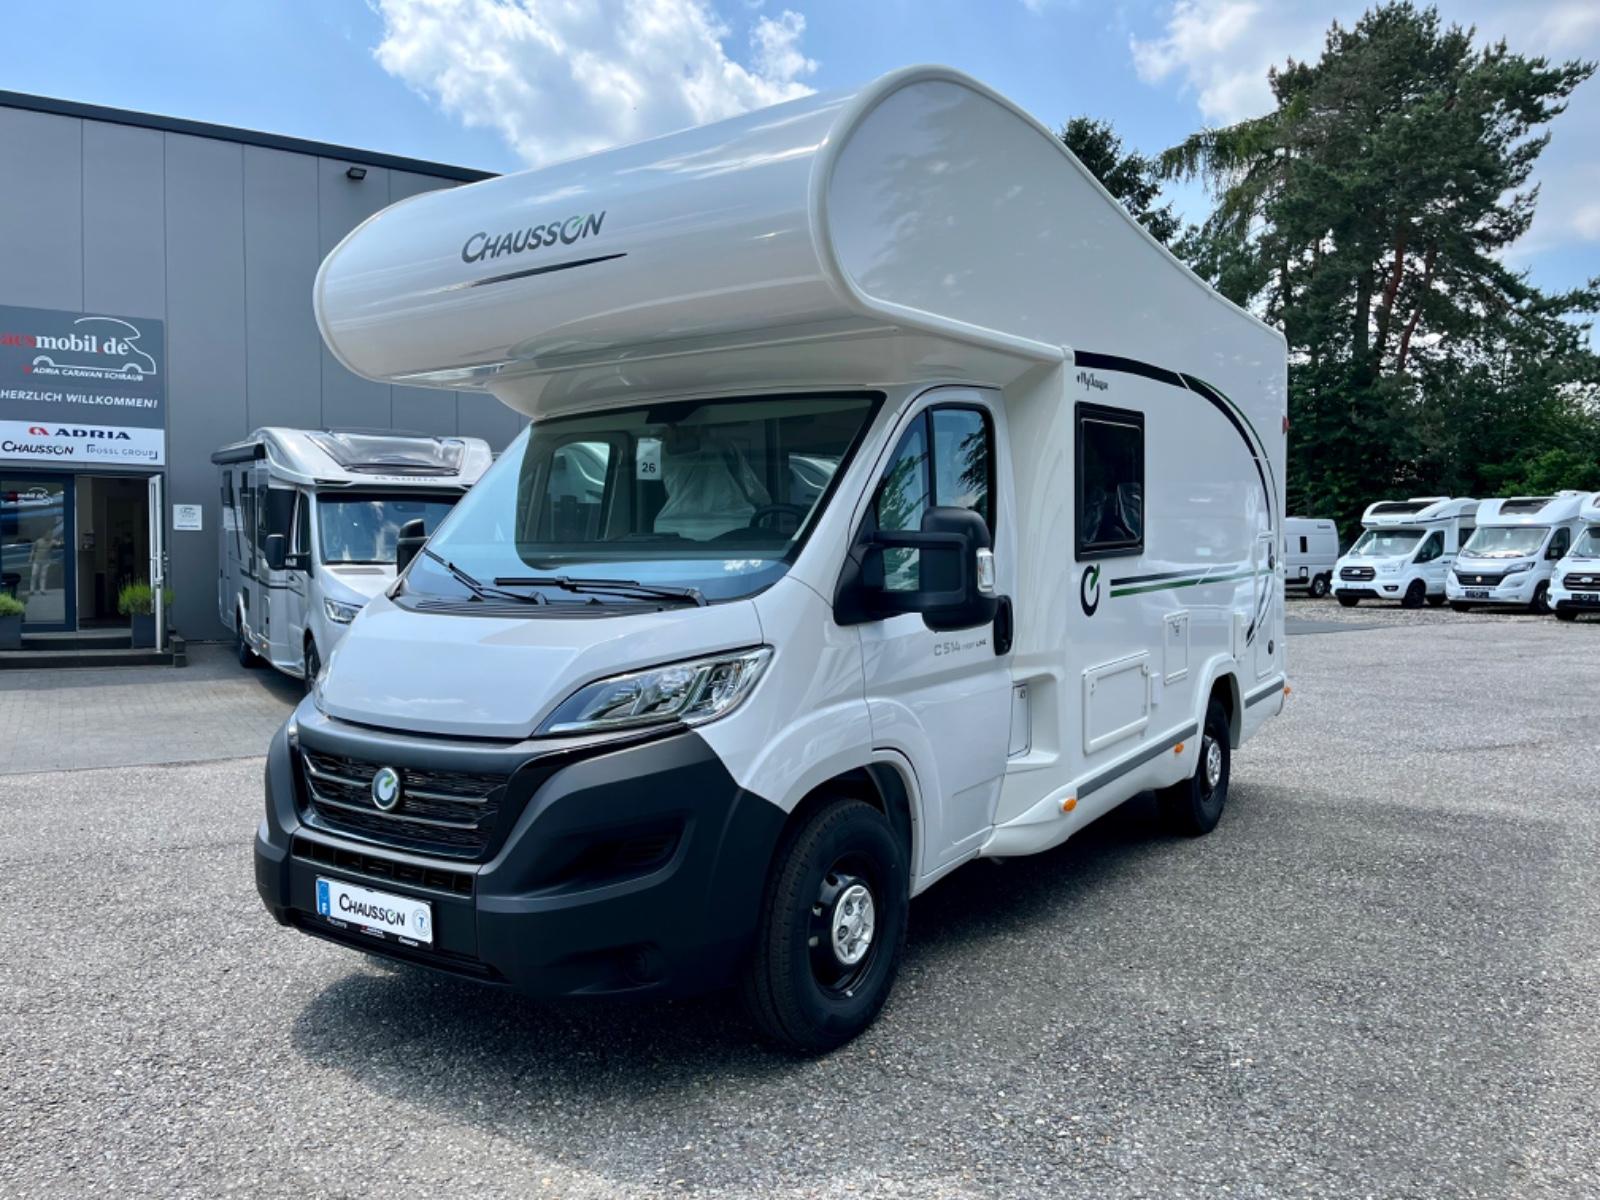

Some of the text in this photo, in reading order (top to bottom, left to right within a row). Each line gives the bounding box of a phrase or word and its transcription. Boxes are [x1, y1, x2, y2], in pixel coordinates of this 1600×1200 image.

[461, 210, 607, 263] CHAUSSON
[62, 368, 102, 377] CARAVAN
[1, 389, 158, 408] HERZLICH WILLKOMMEN!
[55, 428, 131, 440] ADRIA
[1, 440, 74, 455] CHAUSSON
[122, 448, 155, 457] GROUP
[642, 461, 656, 473] 26
[339, 893, 406, 926] CHAUSSON
